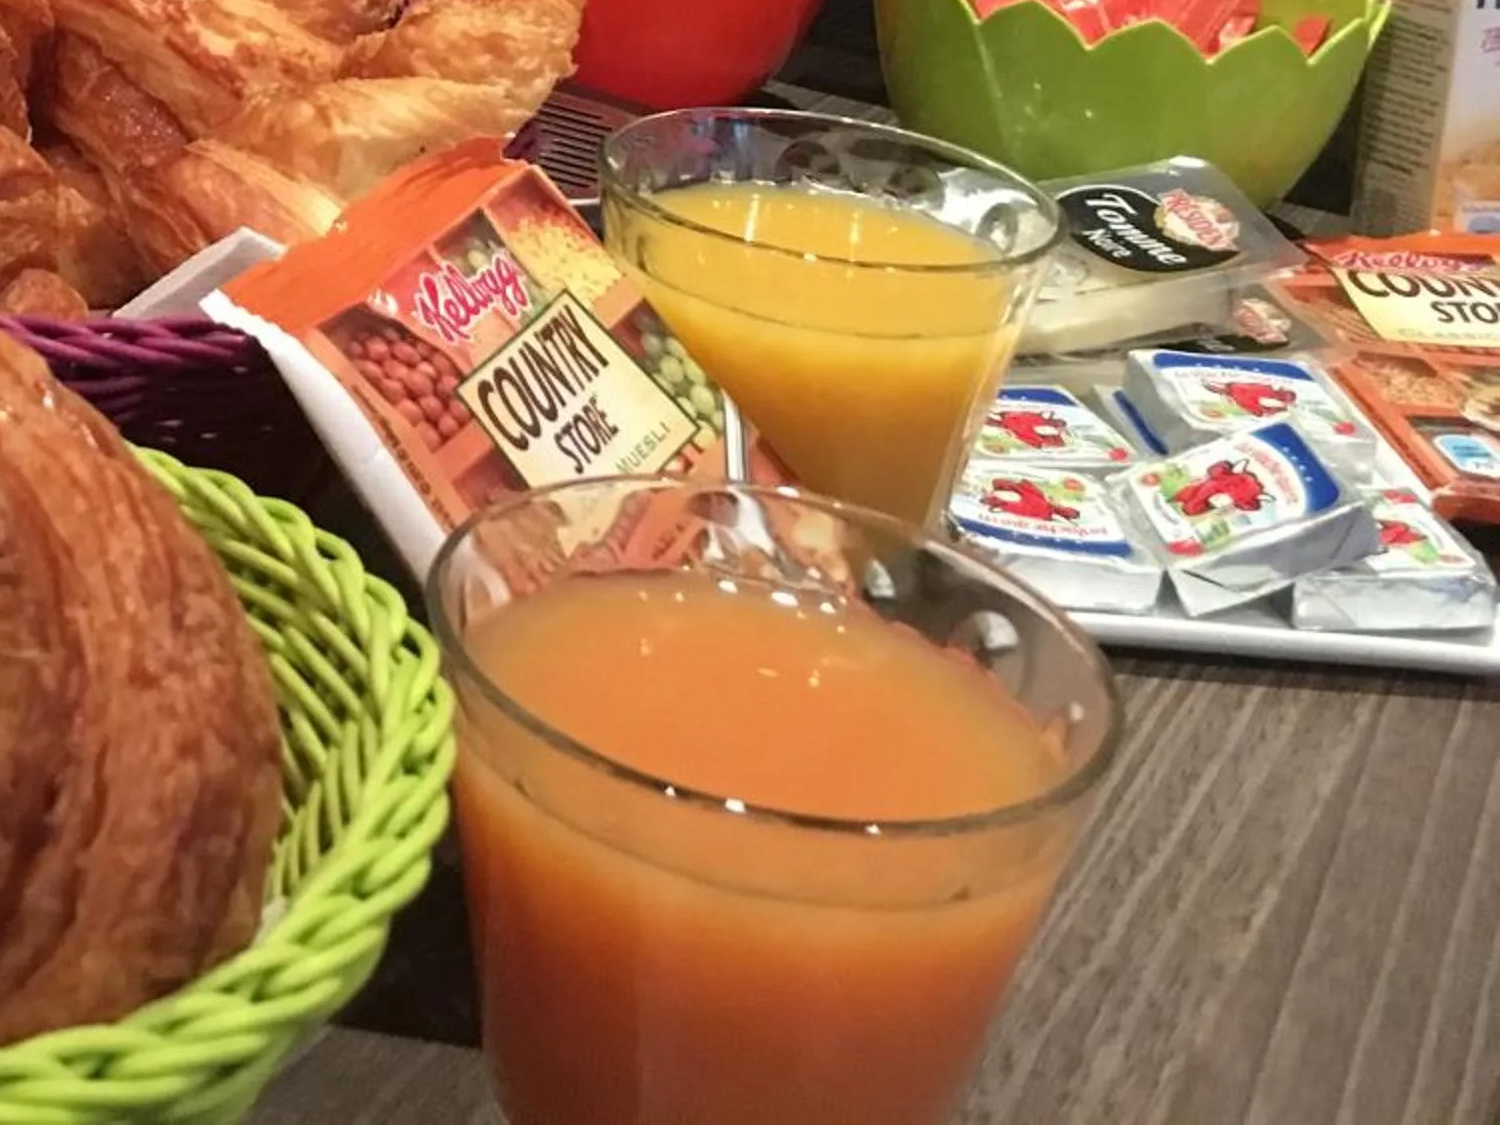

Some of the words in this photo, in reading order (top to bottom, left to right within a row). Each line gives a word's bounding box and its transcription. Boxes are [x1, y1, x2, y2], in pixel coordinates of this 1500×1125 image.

[1085, 193, 1188, 265] Tomme
[1430, 301, 1500, 324] STO
[477, 304, 609, 452] COUNTRY
[554, 393, 619, 475] STORE
